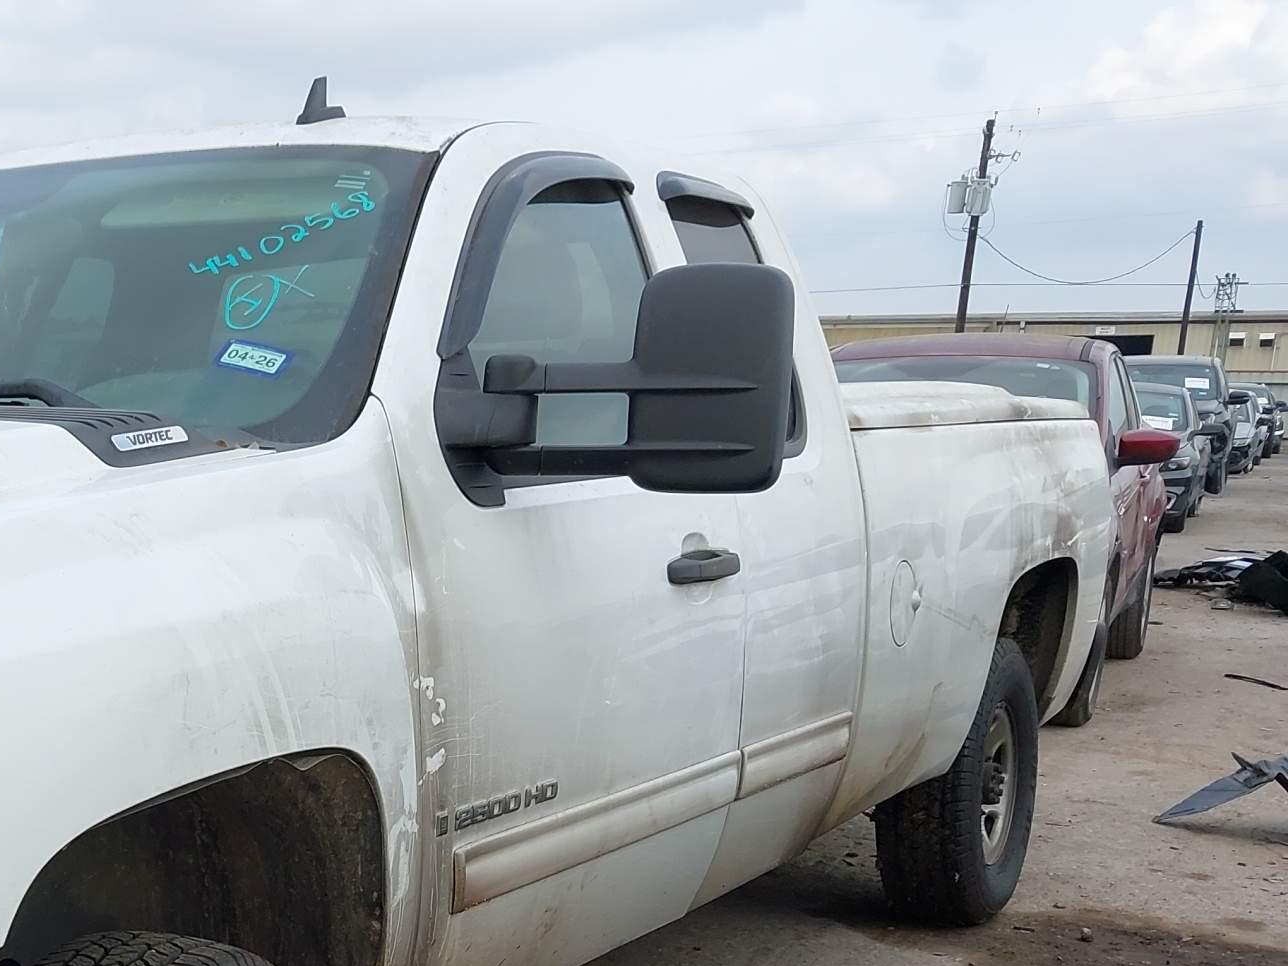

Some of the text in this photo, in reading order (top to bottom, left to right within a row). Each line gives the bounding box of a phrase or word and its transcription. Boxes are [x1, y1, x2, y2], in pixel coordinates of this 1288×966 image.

[188, 191, 376, 275] 44102568
[226, 349, 249, 362] 04
[254, 354, 279, 369] 26
[126, 429, 174, 446] VORTEC
[454, 779, 559, 832] 2500 HD
